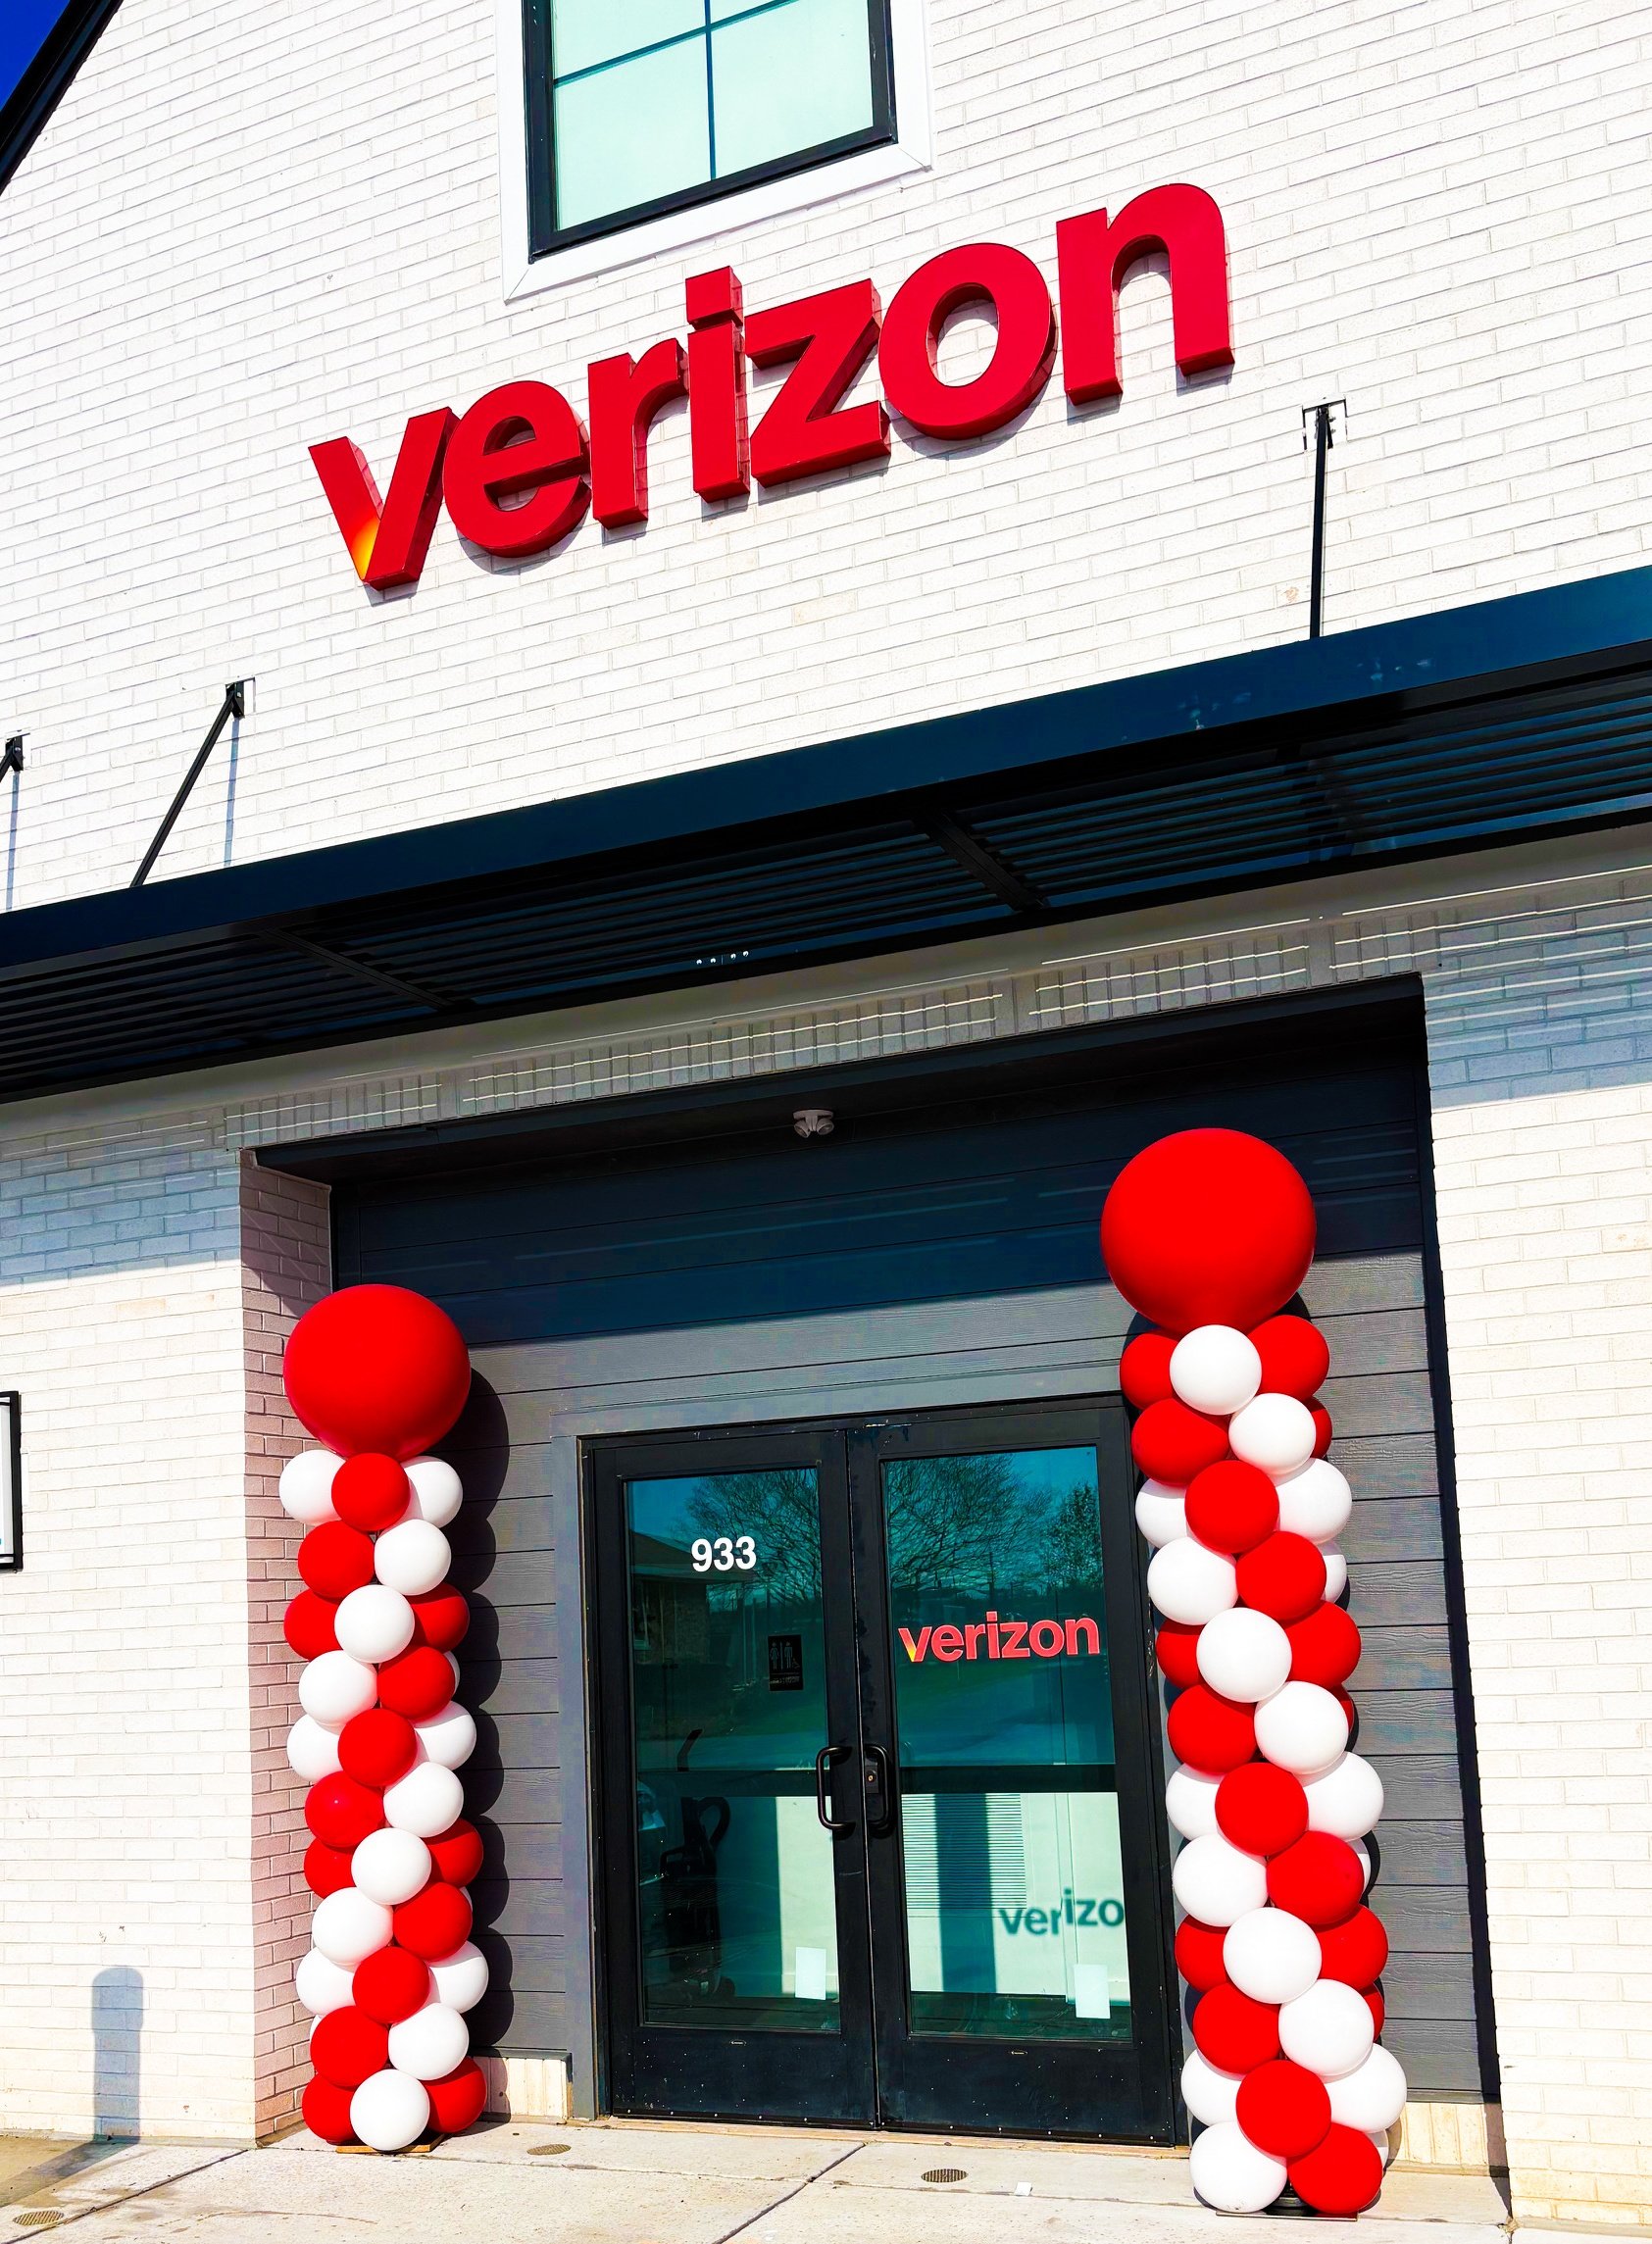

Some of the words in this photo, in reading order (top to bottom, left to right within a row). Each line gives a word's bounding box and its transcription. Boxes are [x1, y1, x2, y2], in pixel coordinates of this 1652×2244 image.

[308, 181, 1235, 590] verizon
[691, 1535, 757, 1572] 933
[898, 1611, 1101, 1663] verizon
[998, 1887, 1125, 1936] verizo
